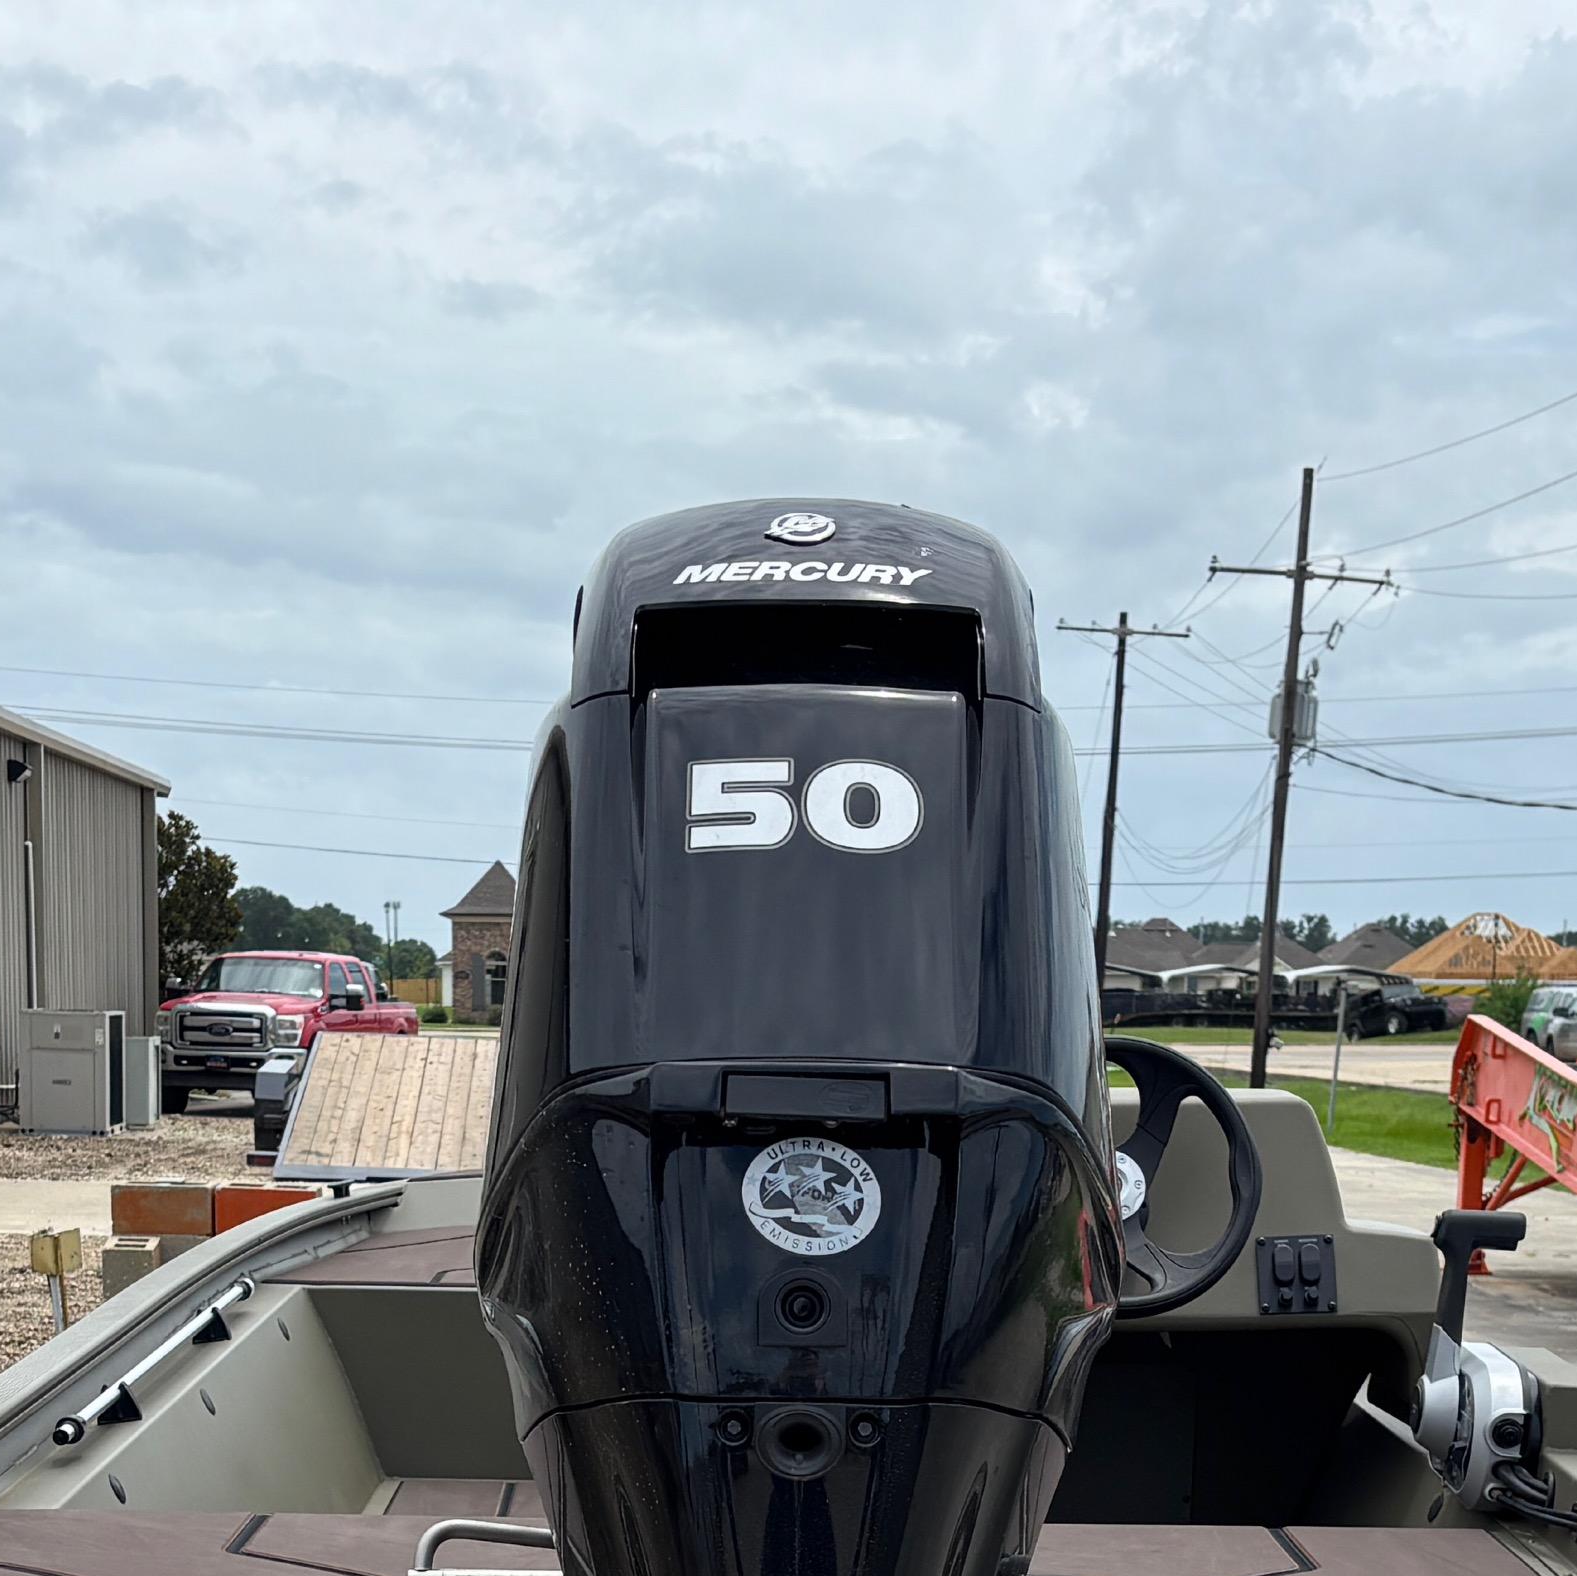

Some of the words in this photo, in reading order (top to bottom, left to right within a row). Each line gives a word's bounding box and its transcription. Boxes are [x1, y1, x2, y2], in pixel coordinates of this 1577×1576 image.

[672, 561, 934, 586] MERCURY
[684, 758, 924, 853] 50
[767, 1139, 825, 1160] ULTRA
[840, 1151, 873, 1183] LOW
